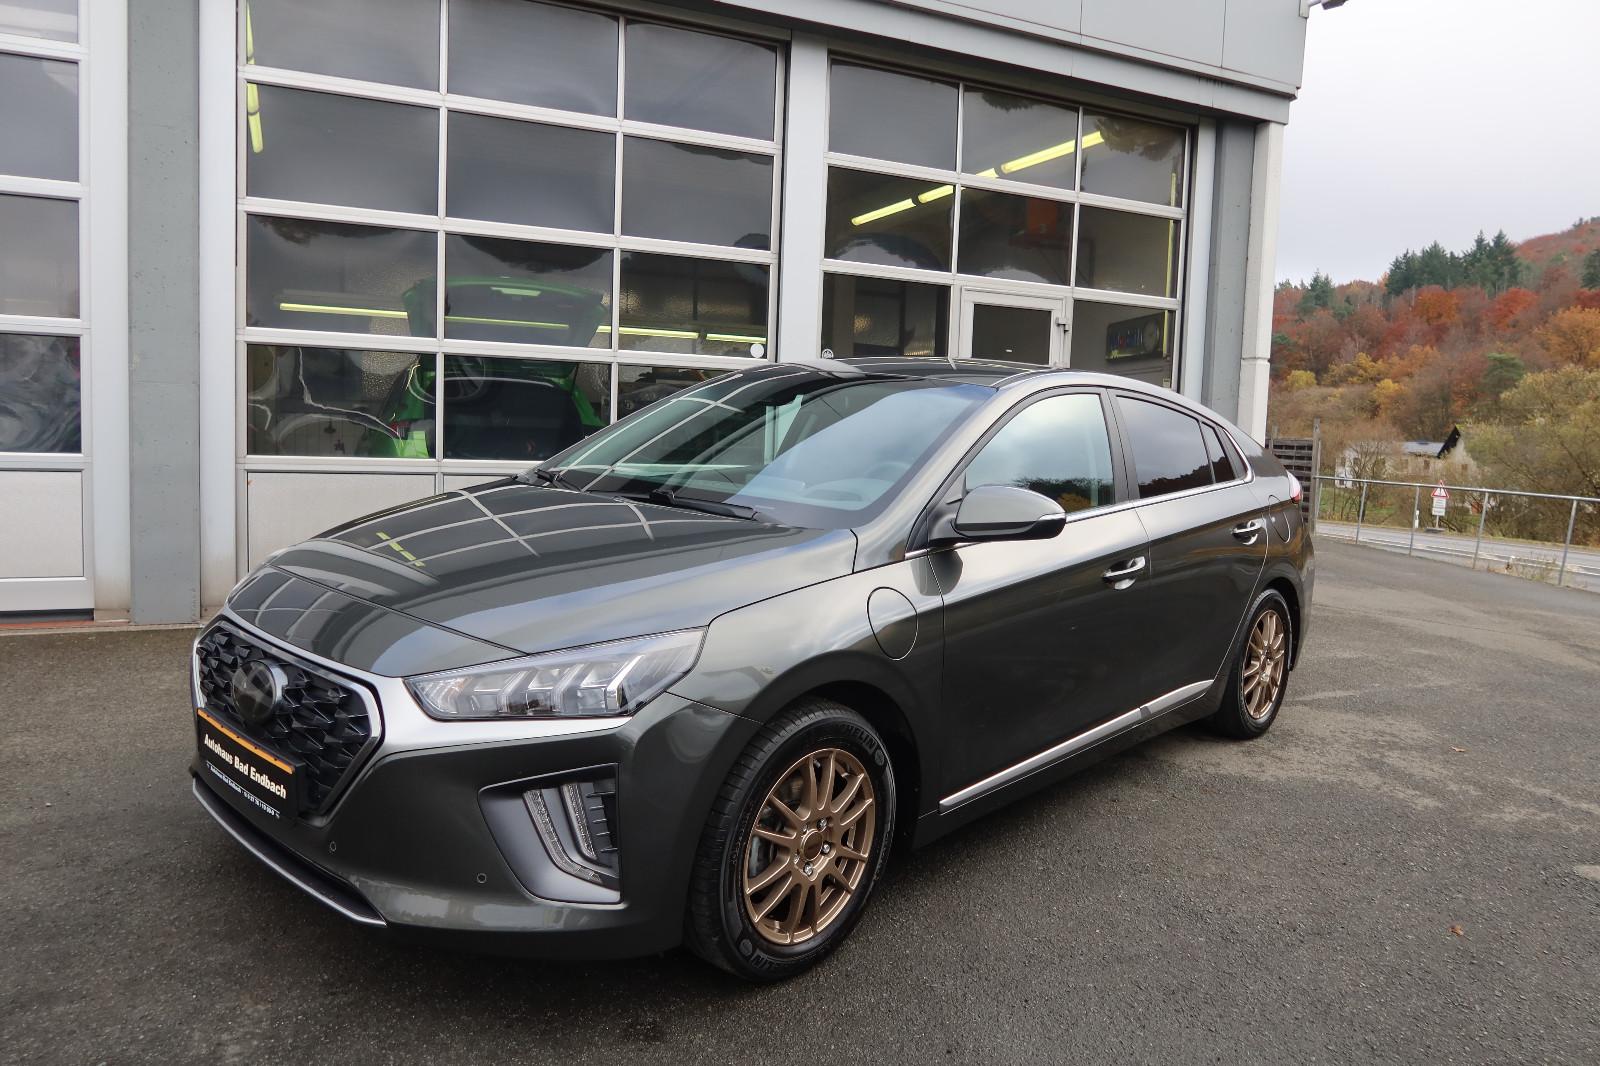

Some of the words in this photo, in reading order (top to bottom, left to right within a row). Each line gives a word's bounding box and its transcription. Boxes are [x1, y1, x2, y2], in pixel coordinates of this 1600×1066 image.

[204, 733, 234, 764] Autohaus
[234, 755, 249, 776] Bad
[250, 765, 287, 800] Endbach
